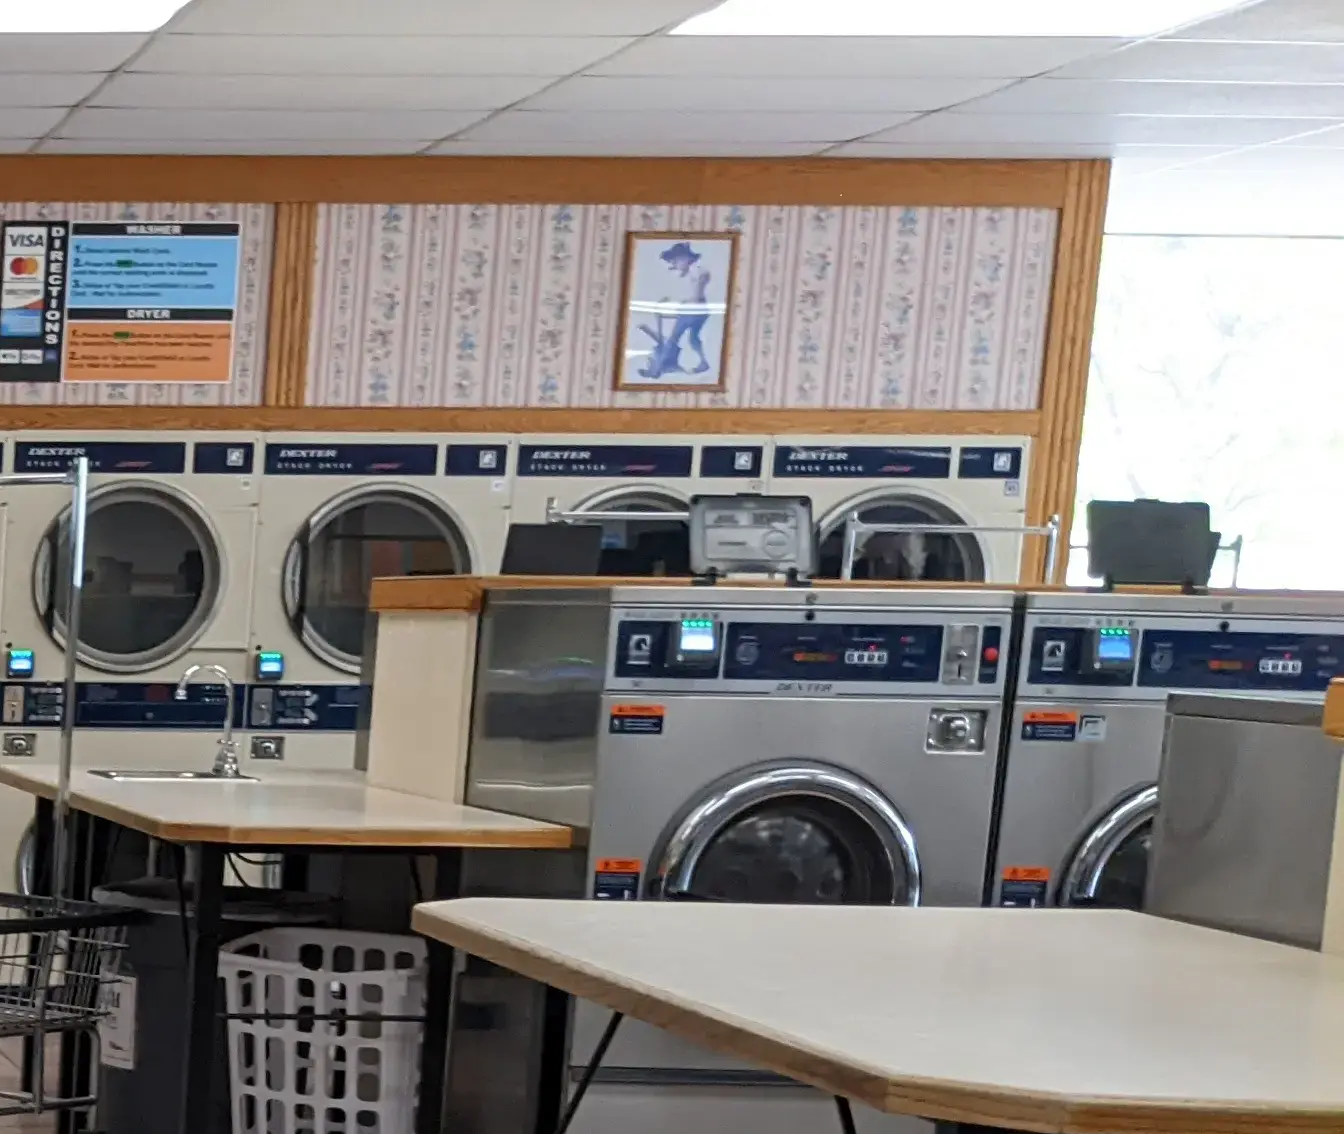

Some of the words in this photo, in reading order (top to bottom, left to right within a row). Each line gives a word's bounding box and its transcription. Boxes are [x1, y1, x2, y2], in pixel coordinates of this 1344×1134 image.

[126, 225, 182, 234] WASHER
[9, 234, 44, 247] VISA
[45, 226, 65, 345] DIRECTIONS
[127, 309, 171, 319] DRYER
[28, 447, 86, 456] DEXTER
[279, 449, 338, 458] DEXTER
[532, 451, 591, 459] DEXTER
[788, 451, 848, 461] DEXTER
